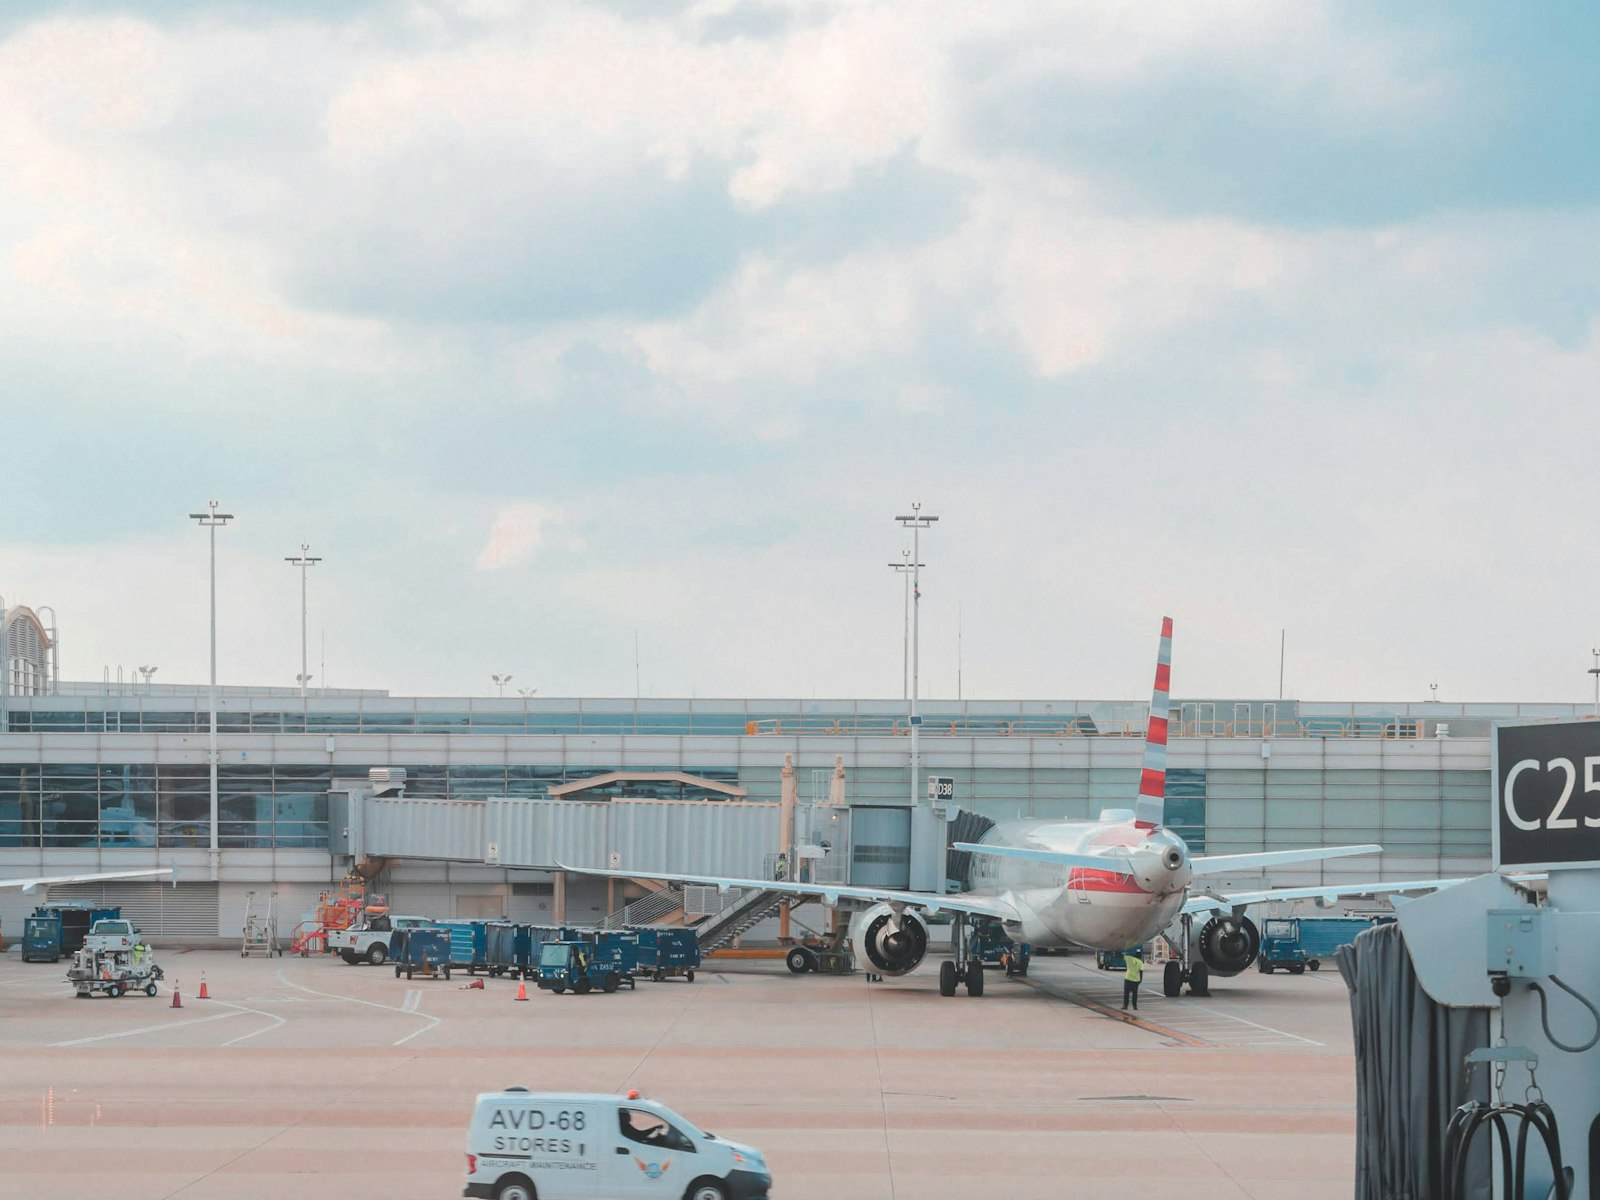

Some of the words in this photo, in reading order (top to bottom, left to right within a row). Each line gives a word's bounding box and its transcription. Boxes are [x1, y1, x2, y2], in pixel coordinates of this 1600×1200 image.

[938, 783, 952, 795] D38
[1504, 756, 1600, 831] C25
[489, 1109, 585, 1131] AVD-68
[494, 1136, 571, 1153] STORES
[530, 1161, 597, 1171] MAINTENANCE
